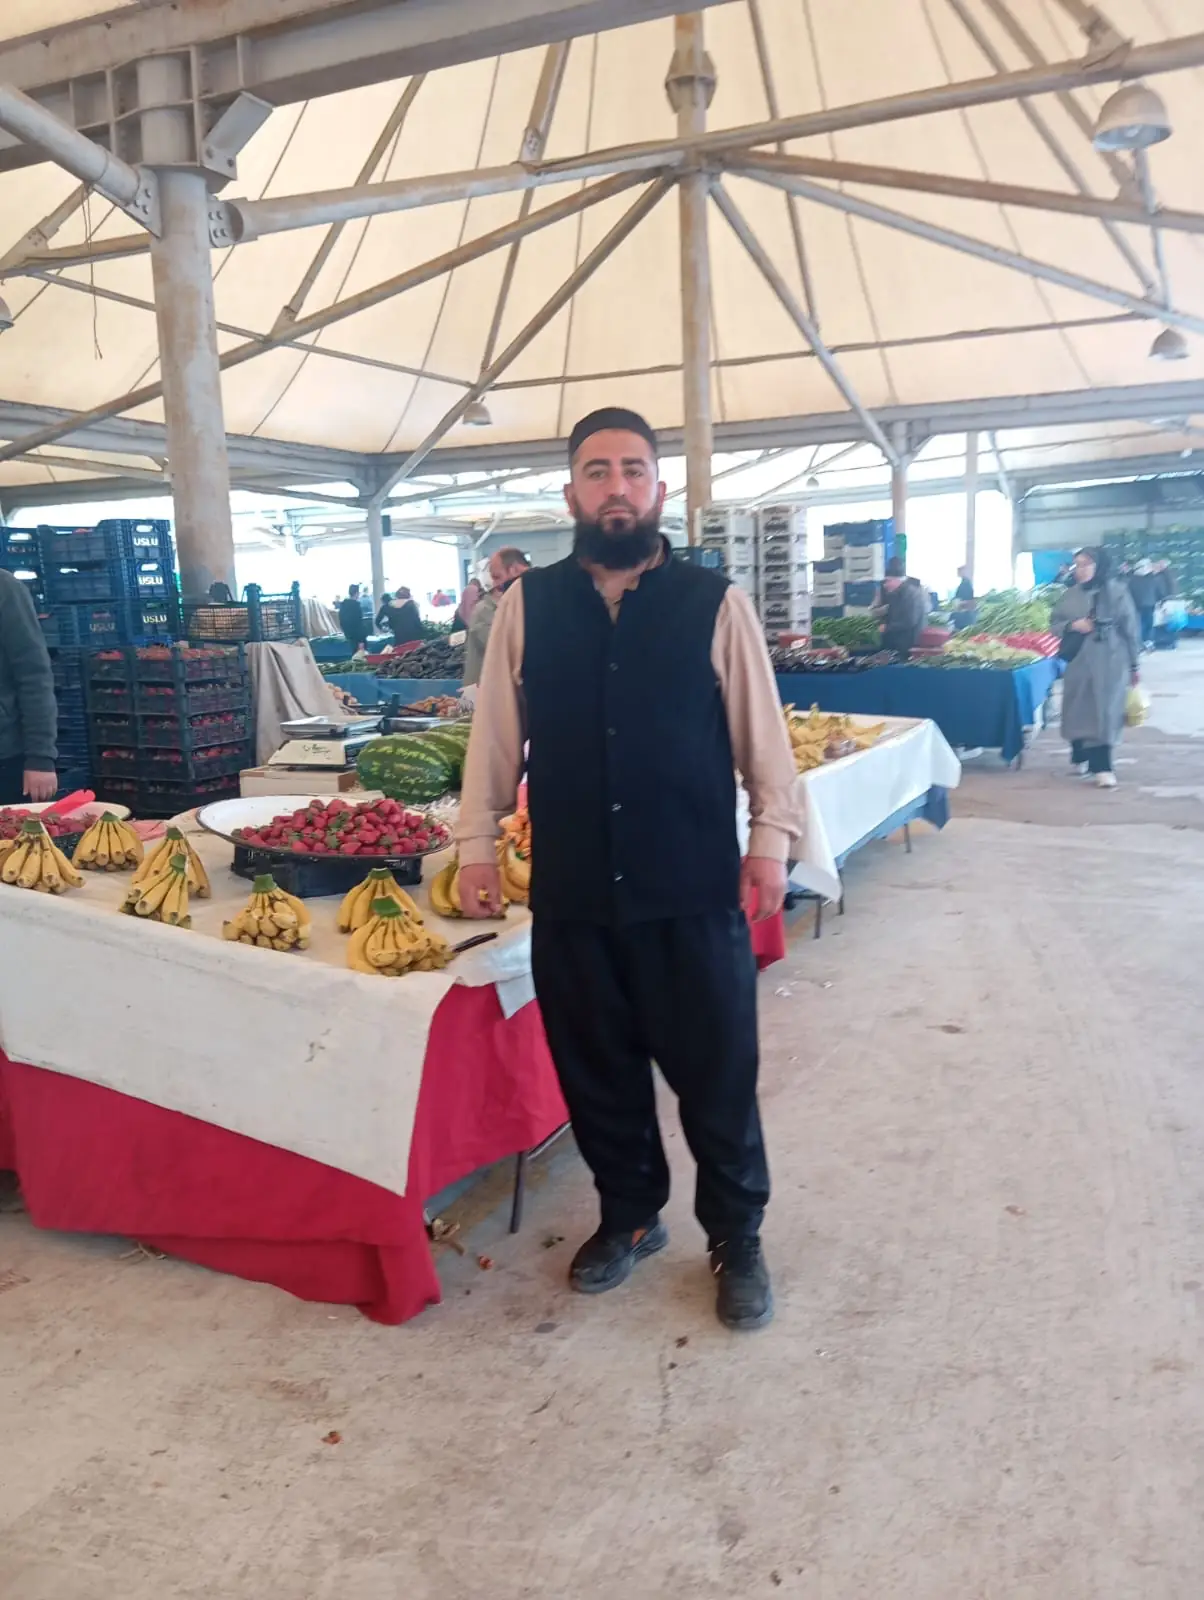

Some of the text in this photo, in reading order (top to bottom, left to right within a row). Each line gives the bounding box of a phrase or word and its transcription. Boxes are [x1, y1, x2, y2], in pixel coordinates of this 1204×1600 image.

[133, 537, 159, 547] USLU
[137, 575, 164, 585] USLU
[142, 614, 168, 624] USLU
